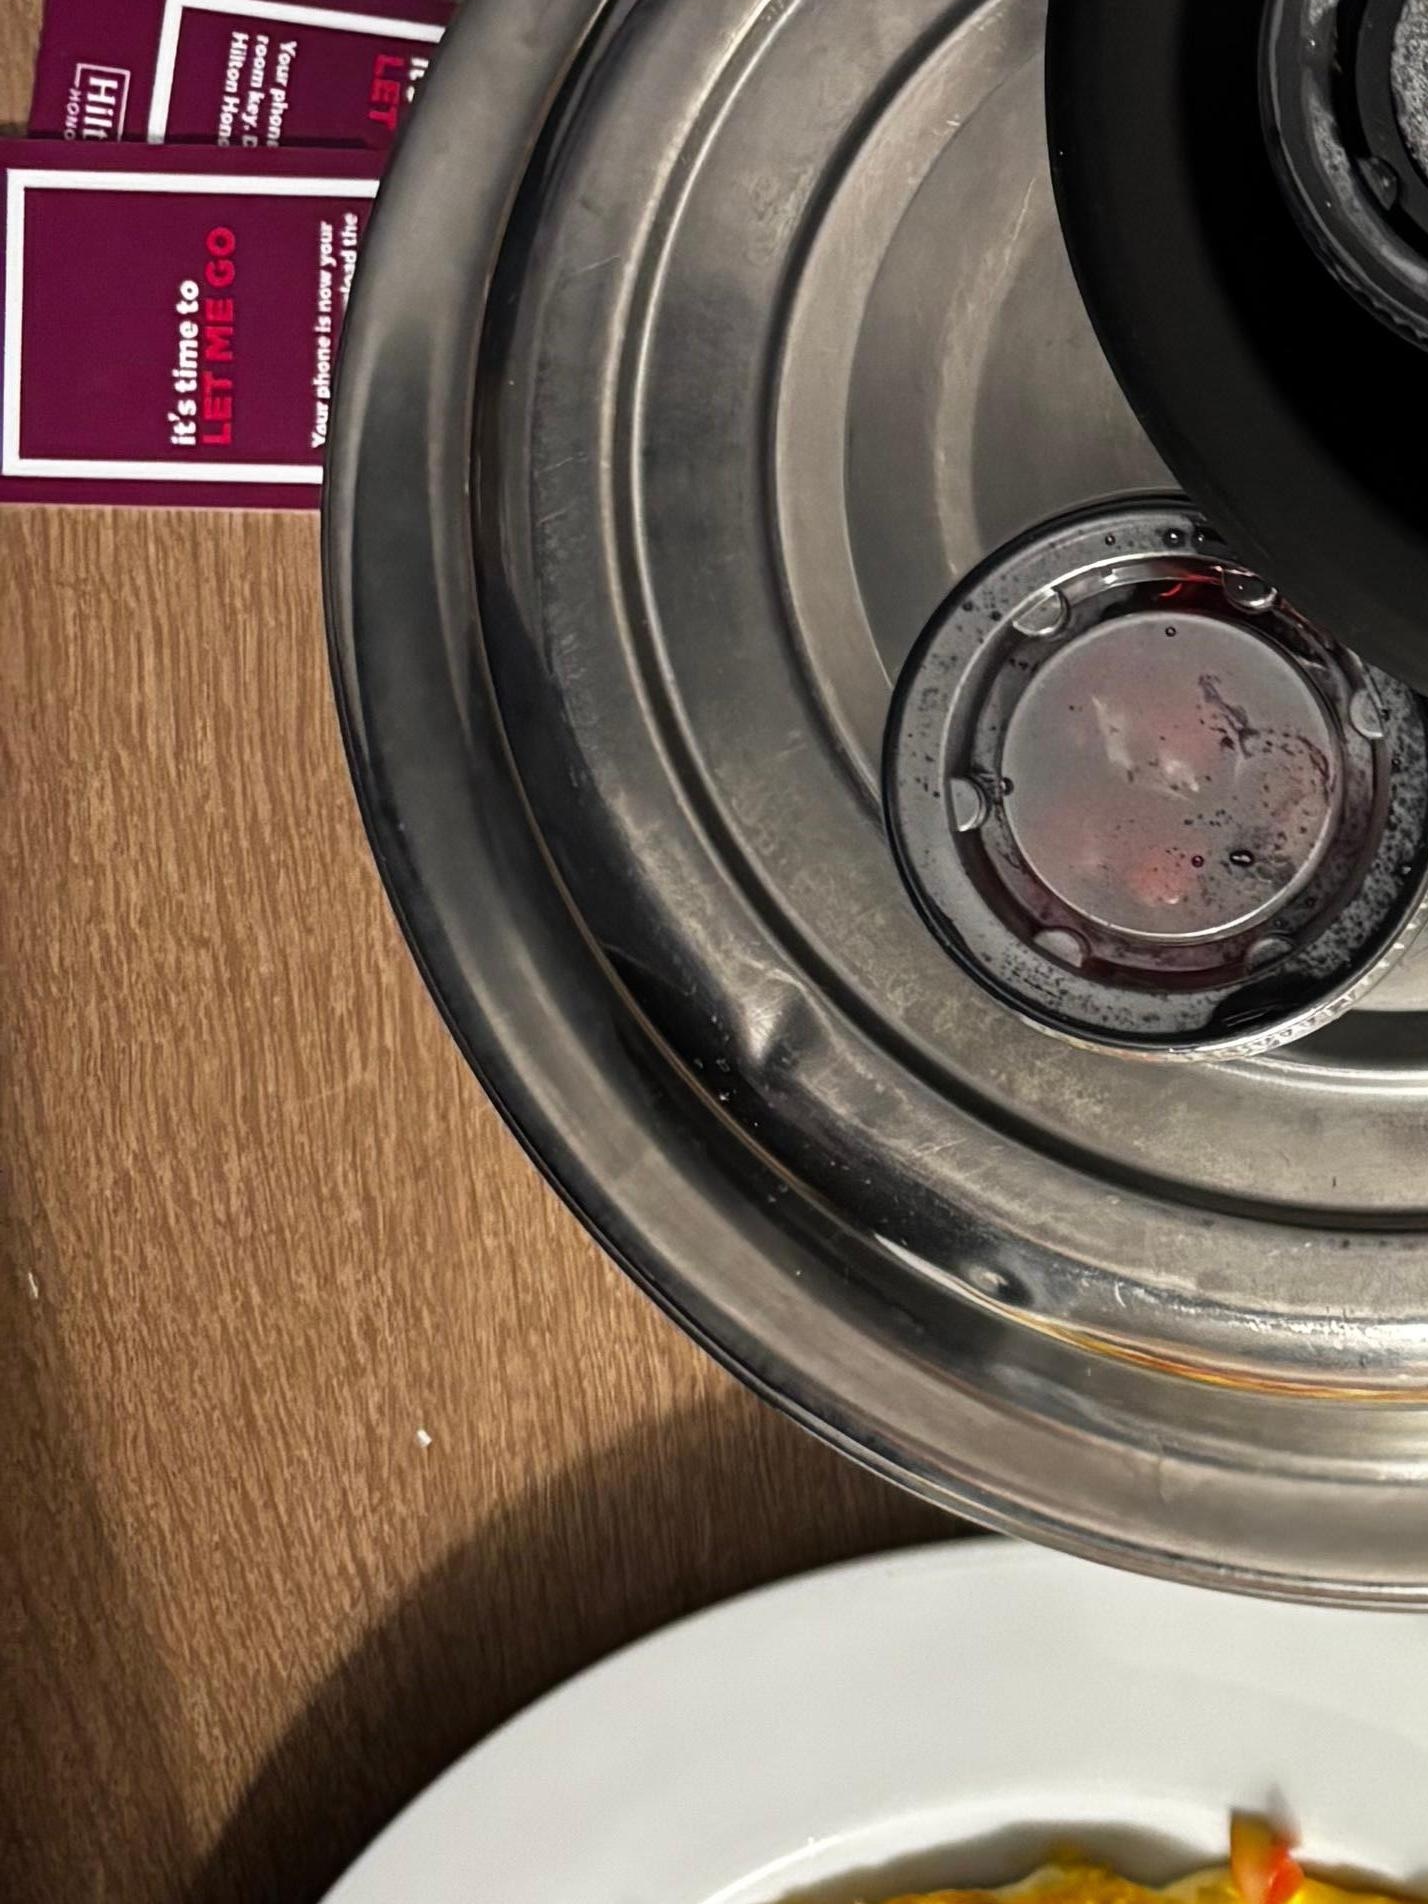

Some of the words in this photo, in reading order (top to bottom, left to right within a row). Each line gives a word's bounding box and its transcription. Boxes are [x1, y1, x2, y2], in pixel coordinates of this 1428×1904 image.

[225, 31, 249, 92] Hilton
[250, 34, 269, 87] room
[275, 41, 297, 84] Your
[65, 88, 81, 140] HONO
[83, 77, 118, 141] Hilt
[241, 89, 264, 131] key.
[368, 54, 405, 131] LET
[320, 221, 336, 266] your
[341, 213, 358, 246] the
[206, 227, 235, 288] GO
[176, 280, 199, 314] to
[315, 270, 331, 312] now
[204, 299, 233, 361] ME
[314, 315, 331, 333] is
[172, 321, 198, 393] time
[313, 336, 331, 399] phone
[168, 399, 196, 445] it's
[203, 371, 232, 444] LET
[311, 402, 328, 448] Your
